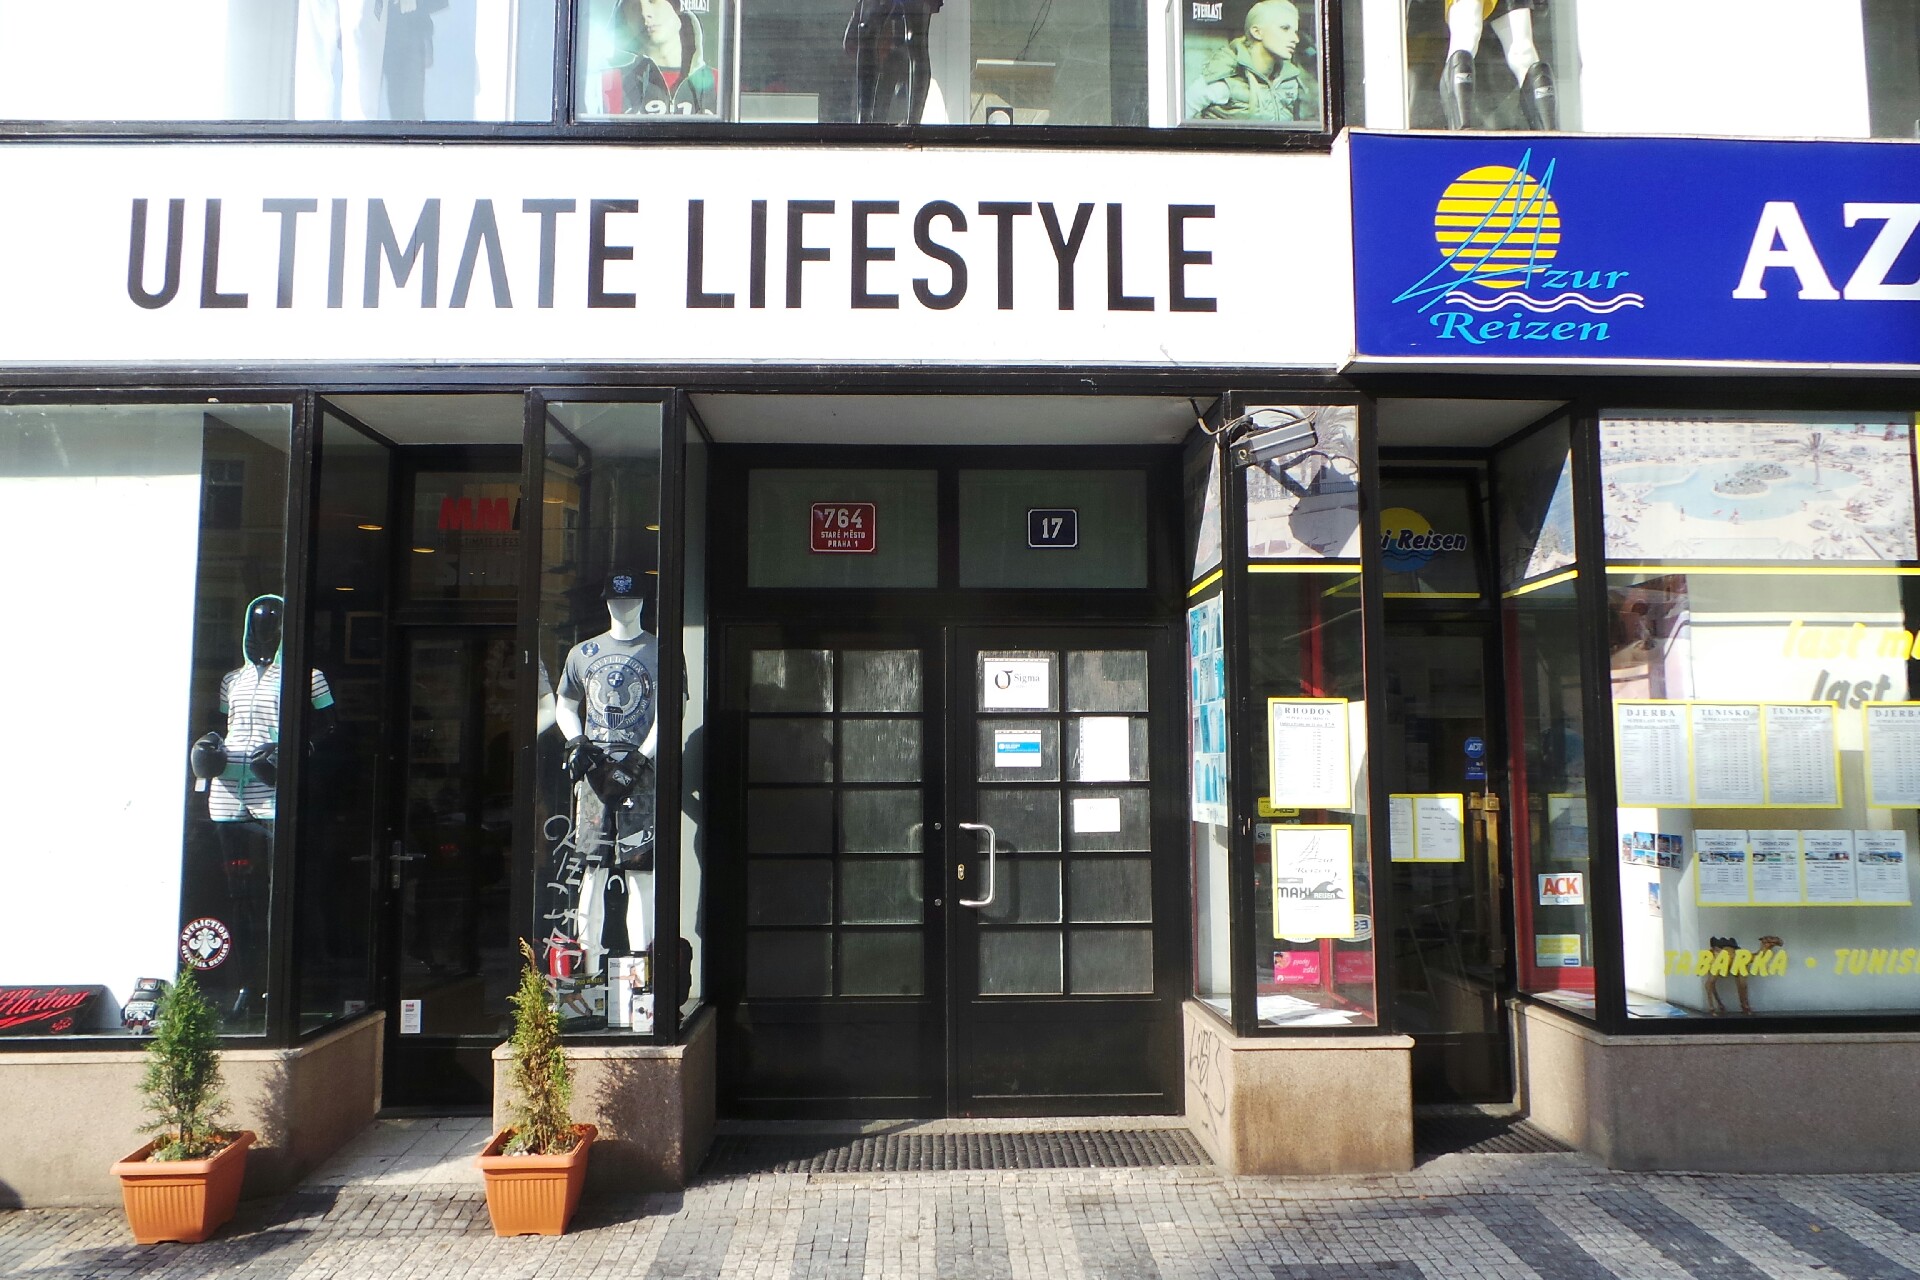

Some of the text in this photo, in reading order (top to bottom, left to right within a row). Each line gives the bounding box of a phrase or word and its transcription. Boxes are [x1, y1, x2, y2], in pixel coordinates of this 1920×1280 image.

[1193, 2, 1222, 20] EVERLAST
[127, 198, 1217, 312] ULTIMATE LIFESTYLE
[1732, 201, 1920, 300] AZ
[1430, 313, 1610, 344] Reizen
[824, 509, 863, 528] 764
[1042, 517, 1063, 539] 17
[821, 529, 866, 539] STARÉ MĚSTO
[1397, 529, 1467, 551] Reisen
[828, 540, 852, 548] PRAHA
[1782, 620, 1866, 659] last
[1014, 673, 1040, 684] Sigma
[1811, 670, 1892, 710] last
[1285, 707, 1331, 715] RHODOS
[1626, 709, 1676, 717] DJERBA
[1701, 709, 1750, 717] TUNISKO
[1772, 707, 1822, 715] TUNISKO
[1467, 743, 1482, 751] ADT
[1278, 887, 1312, 898] MAXI
[1543, 877, 1578, 896] ACK
[182, 919, 229, 941] AFFLICTION
[208, 943, 229, 967] DEALER
[1663, 949, 1788, 977] TABARKA
